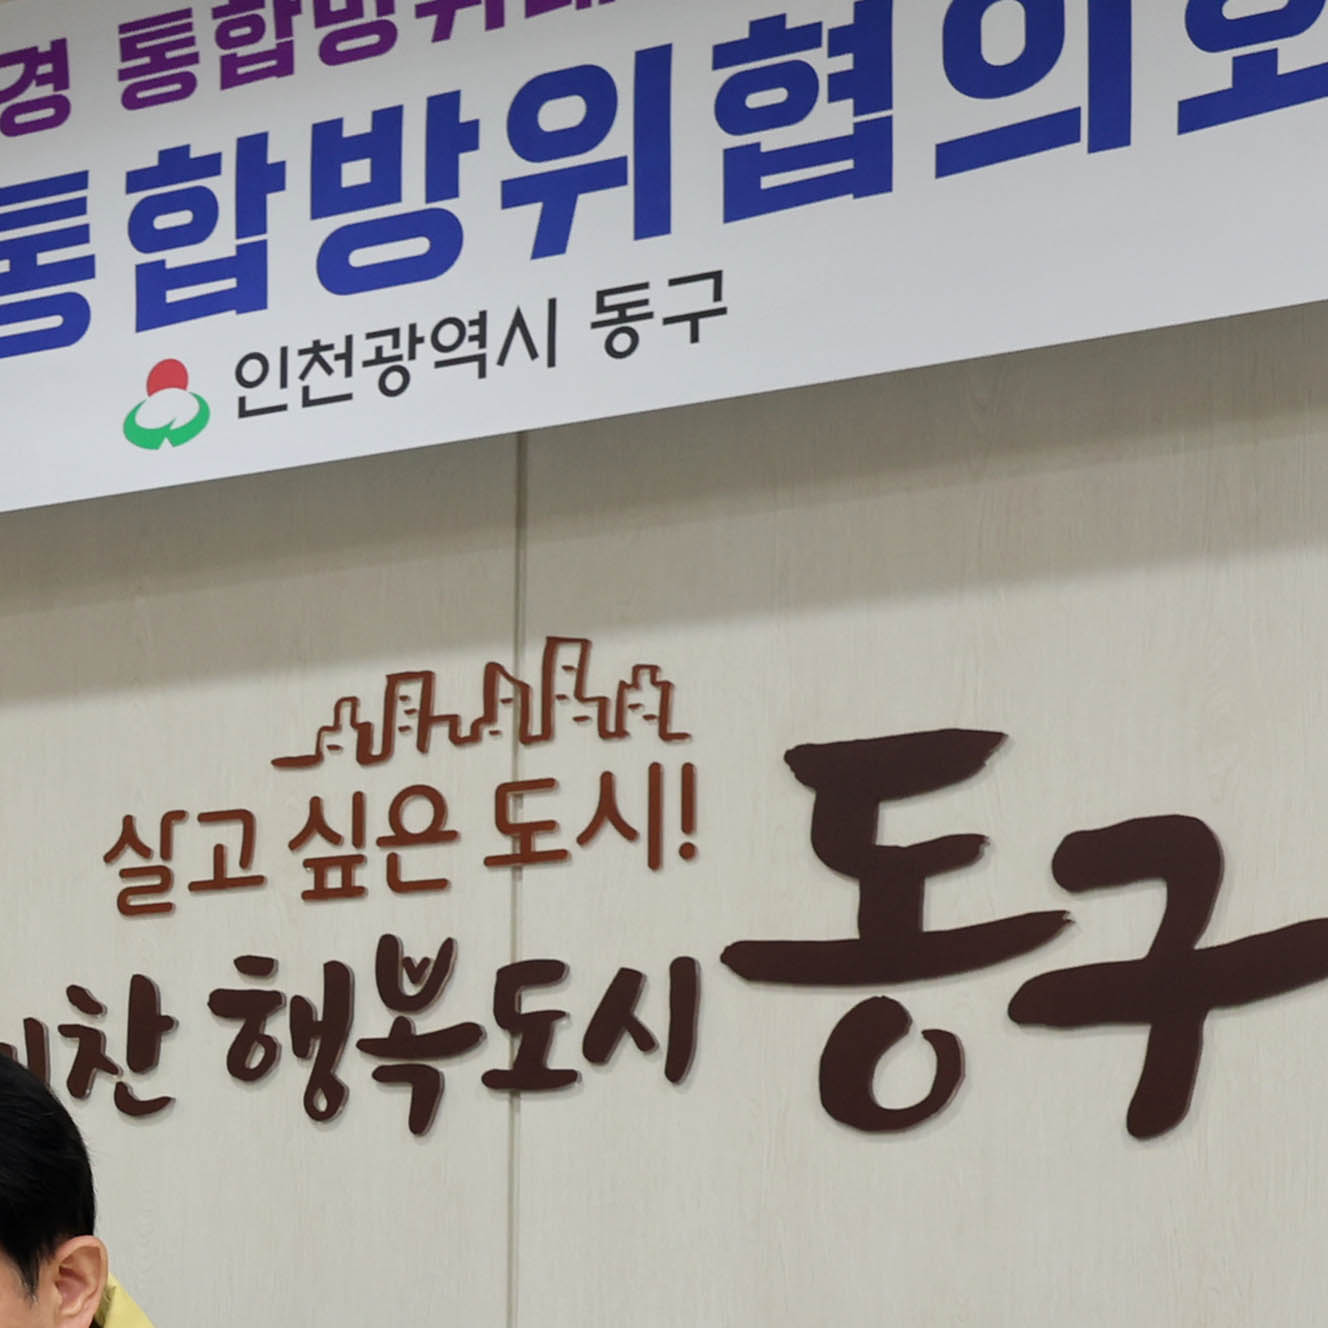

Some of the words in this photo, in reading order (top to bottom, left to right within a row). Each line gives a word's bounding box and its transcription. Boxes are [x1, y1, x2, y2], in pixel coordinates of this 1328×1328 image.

[235, 296, 560, 420] 인천광역시
[589, 269, 729, 368] 동구
[102, 808, 266, 917] 살고
[288, 784, 461, 902] 싶은
[483, 761, 698, 871] 도시!
[206, 933, 701, 1136] 행복도시
[718, 727, 1328, 1140] 동구
